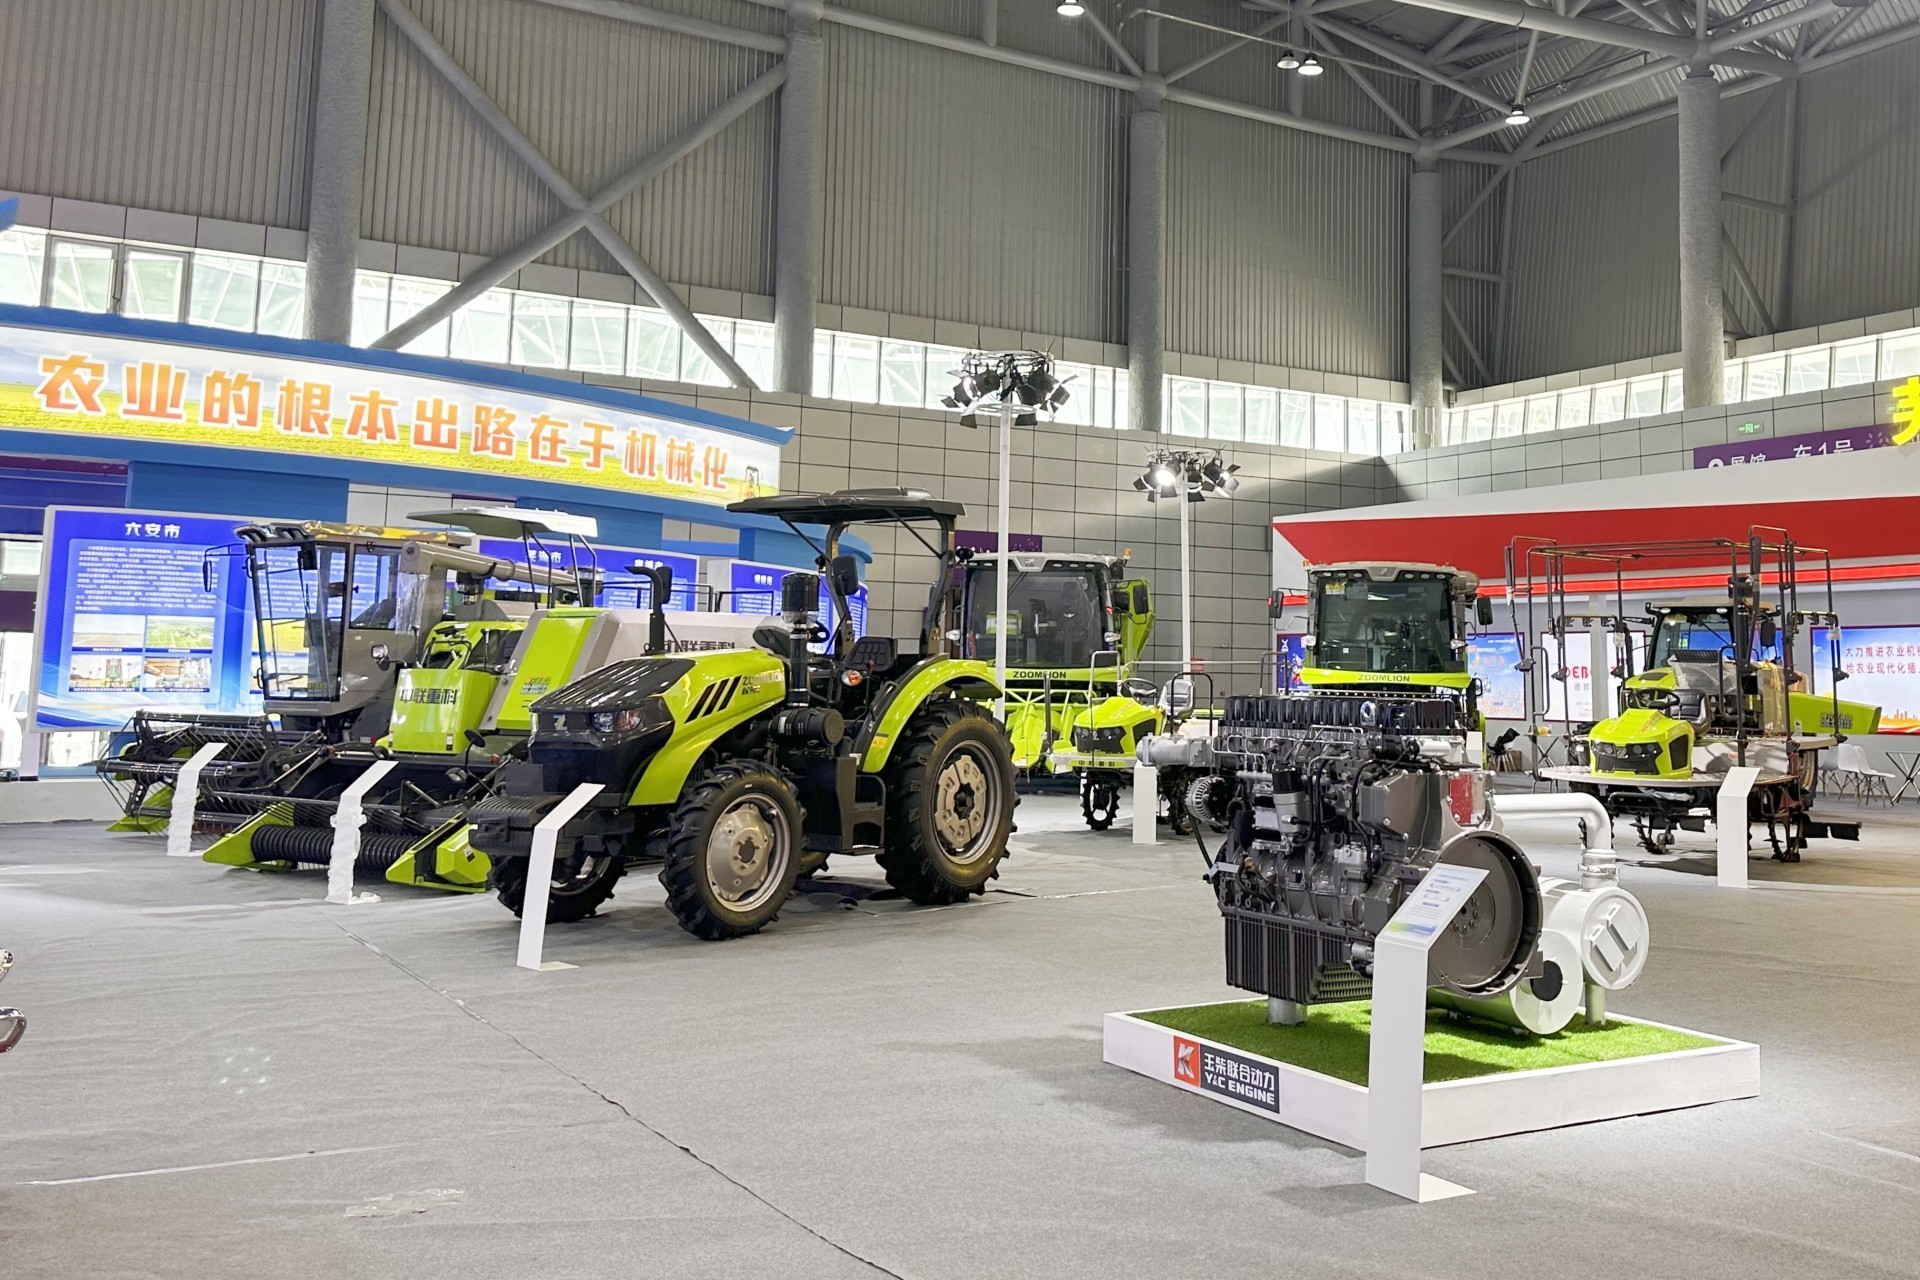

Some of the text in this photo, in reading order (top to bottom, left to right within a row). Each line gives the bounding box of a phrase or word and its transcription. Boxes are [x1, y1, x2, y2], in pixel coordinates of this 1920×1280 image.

[37, 353, 730, 491] 农业的根本出路在于机械化
[124, 521, 181, 539] 六安市
[1845, 662, 1920, 674] 给农业现代化插
[1357, 673, 1411, 683] ZOOMLION
[400, 687, 458, 705] 中联重科
[1204, 1052, 1275, 1091] 玉柴联合动力
[1204, 1071, 1275, 1106] Y&C ENGINE
